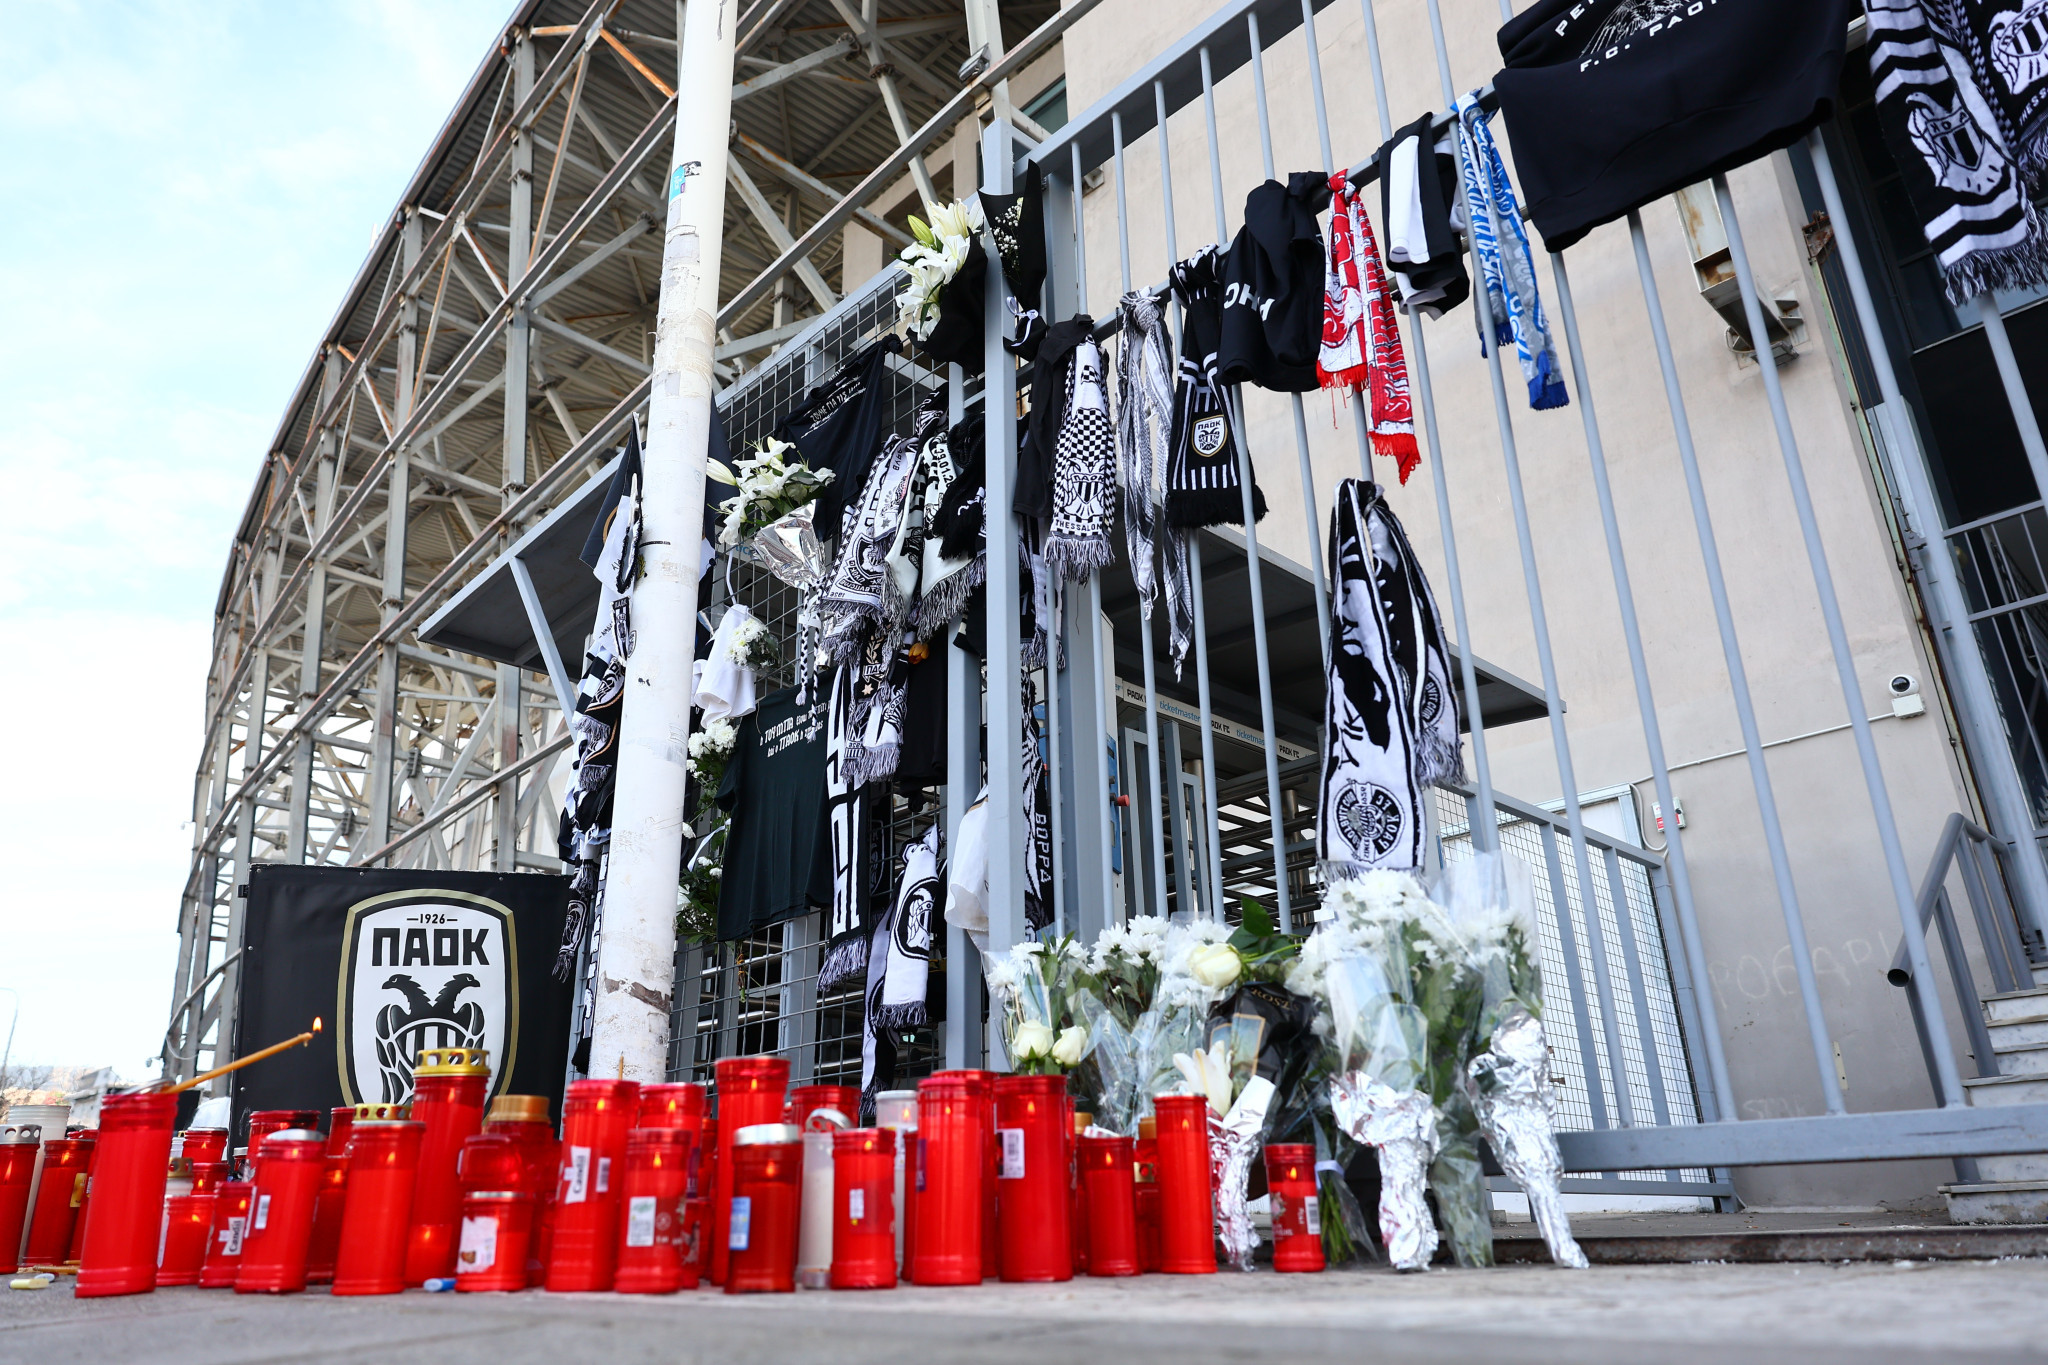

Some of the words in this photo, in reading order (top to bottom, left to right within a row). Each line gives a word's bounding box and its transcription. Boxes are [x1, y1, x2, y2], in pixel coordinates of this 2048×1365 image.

[1580, 44, 1631, 73] F.C.
[1197, 419, 1221, 431] ΠΑΟΚ
[1210, 720, 1222, 732] AOK
[420, 913, 446, 925] 1926
[372, 928, 490, 966] ΠΑΟΚ
